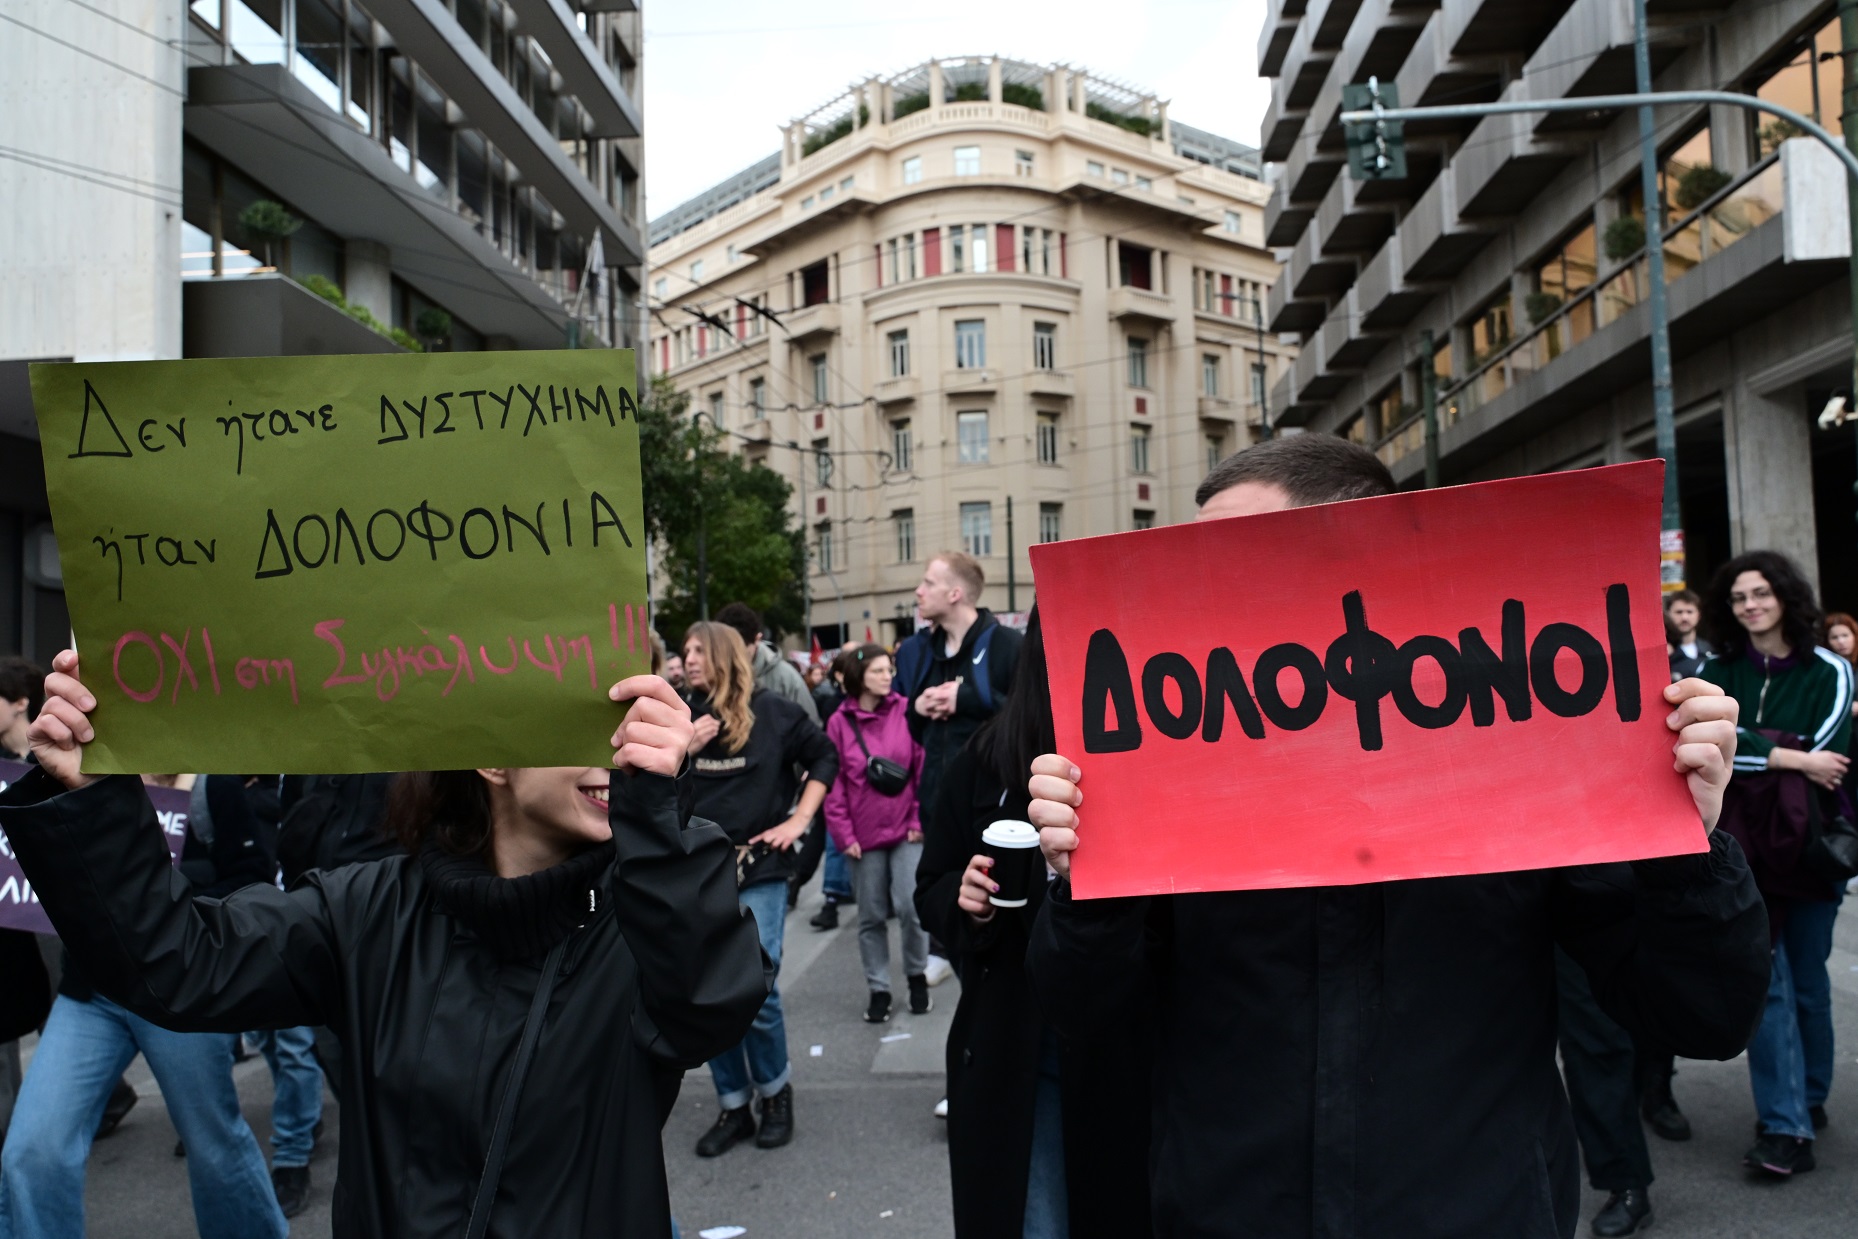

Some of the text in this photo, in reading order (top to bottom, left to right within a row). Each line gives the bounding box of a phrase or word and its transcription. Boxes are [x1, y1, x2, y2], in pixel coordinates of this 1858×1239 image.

[67, 378, 640, 476] Δεν ήτανε ΔΥΣΤΥΧΗΜΑ
[92, 490, 633, 602] ήταν ΔΟΛΟΦΟΝΙΑ
[113, 627, 222, 705] ΟΧΙ
[235, 656, 300, 705] στη
[1081, 582, 1642, 753] ΔΟΛΟΦΟΝΟΙ
